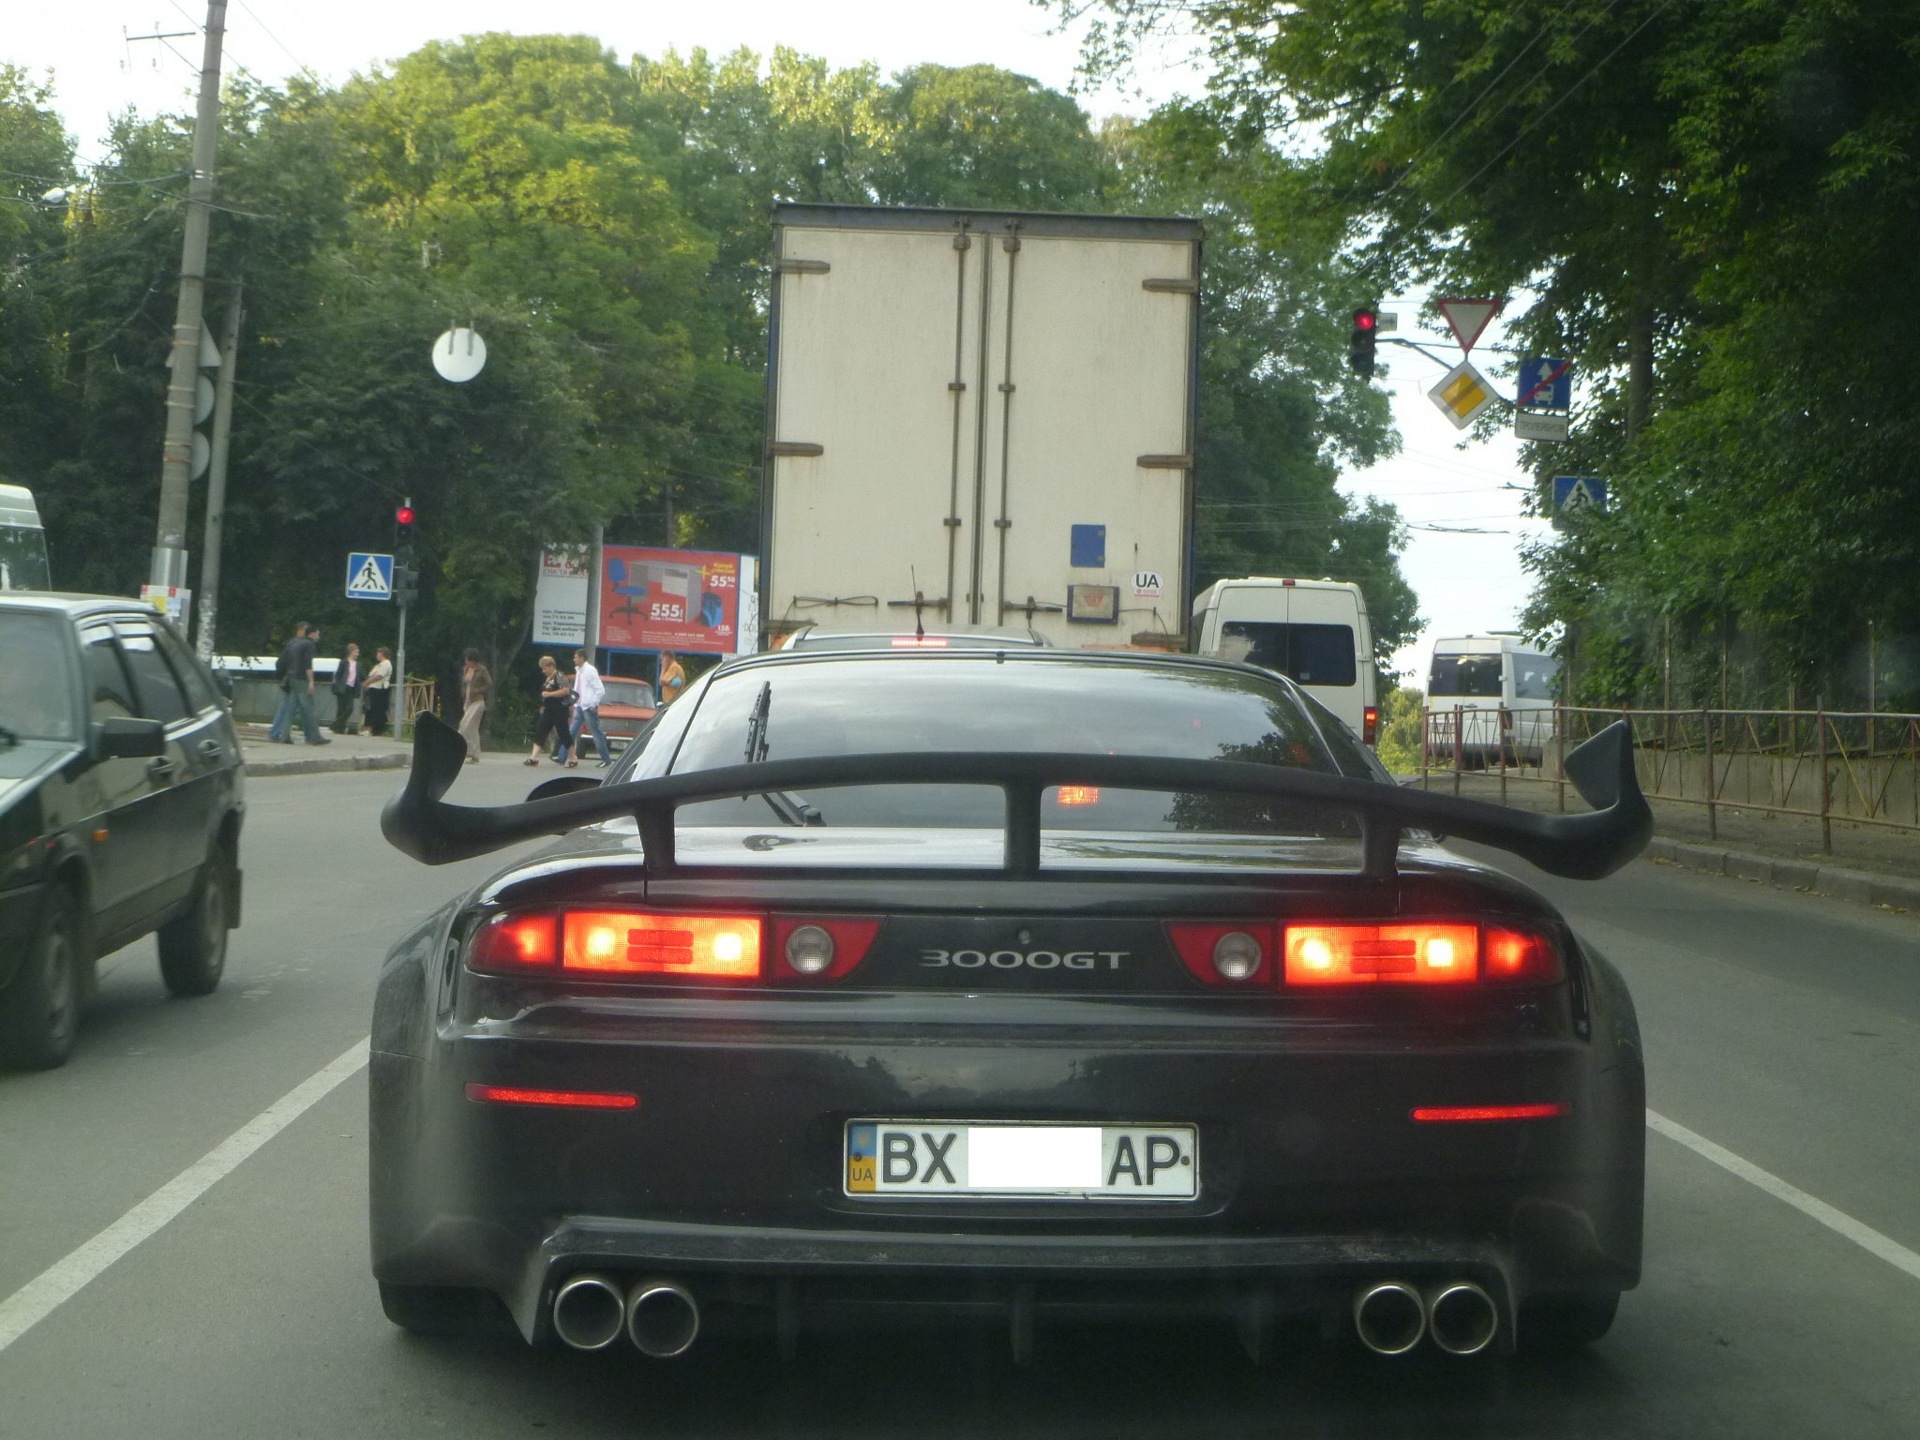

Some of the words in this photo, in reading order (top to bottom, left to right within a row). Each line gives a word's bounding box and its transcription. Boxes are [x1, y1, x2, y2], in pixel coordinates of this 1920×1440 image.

[1135, 573, 1160, 589] UA
[918, 949, 1132, 970] 3000GT
[882, 1132, 957, 1184] BX
[1107, 1136, 1181, 1187] AP
[852, 1167, 874, 1182] UA
